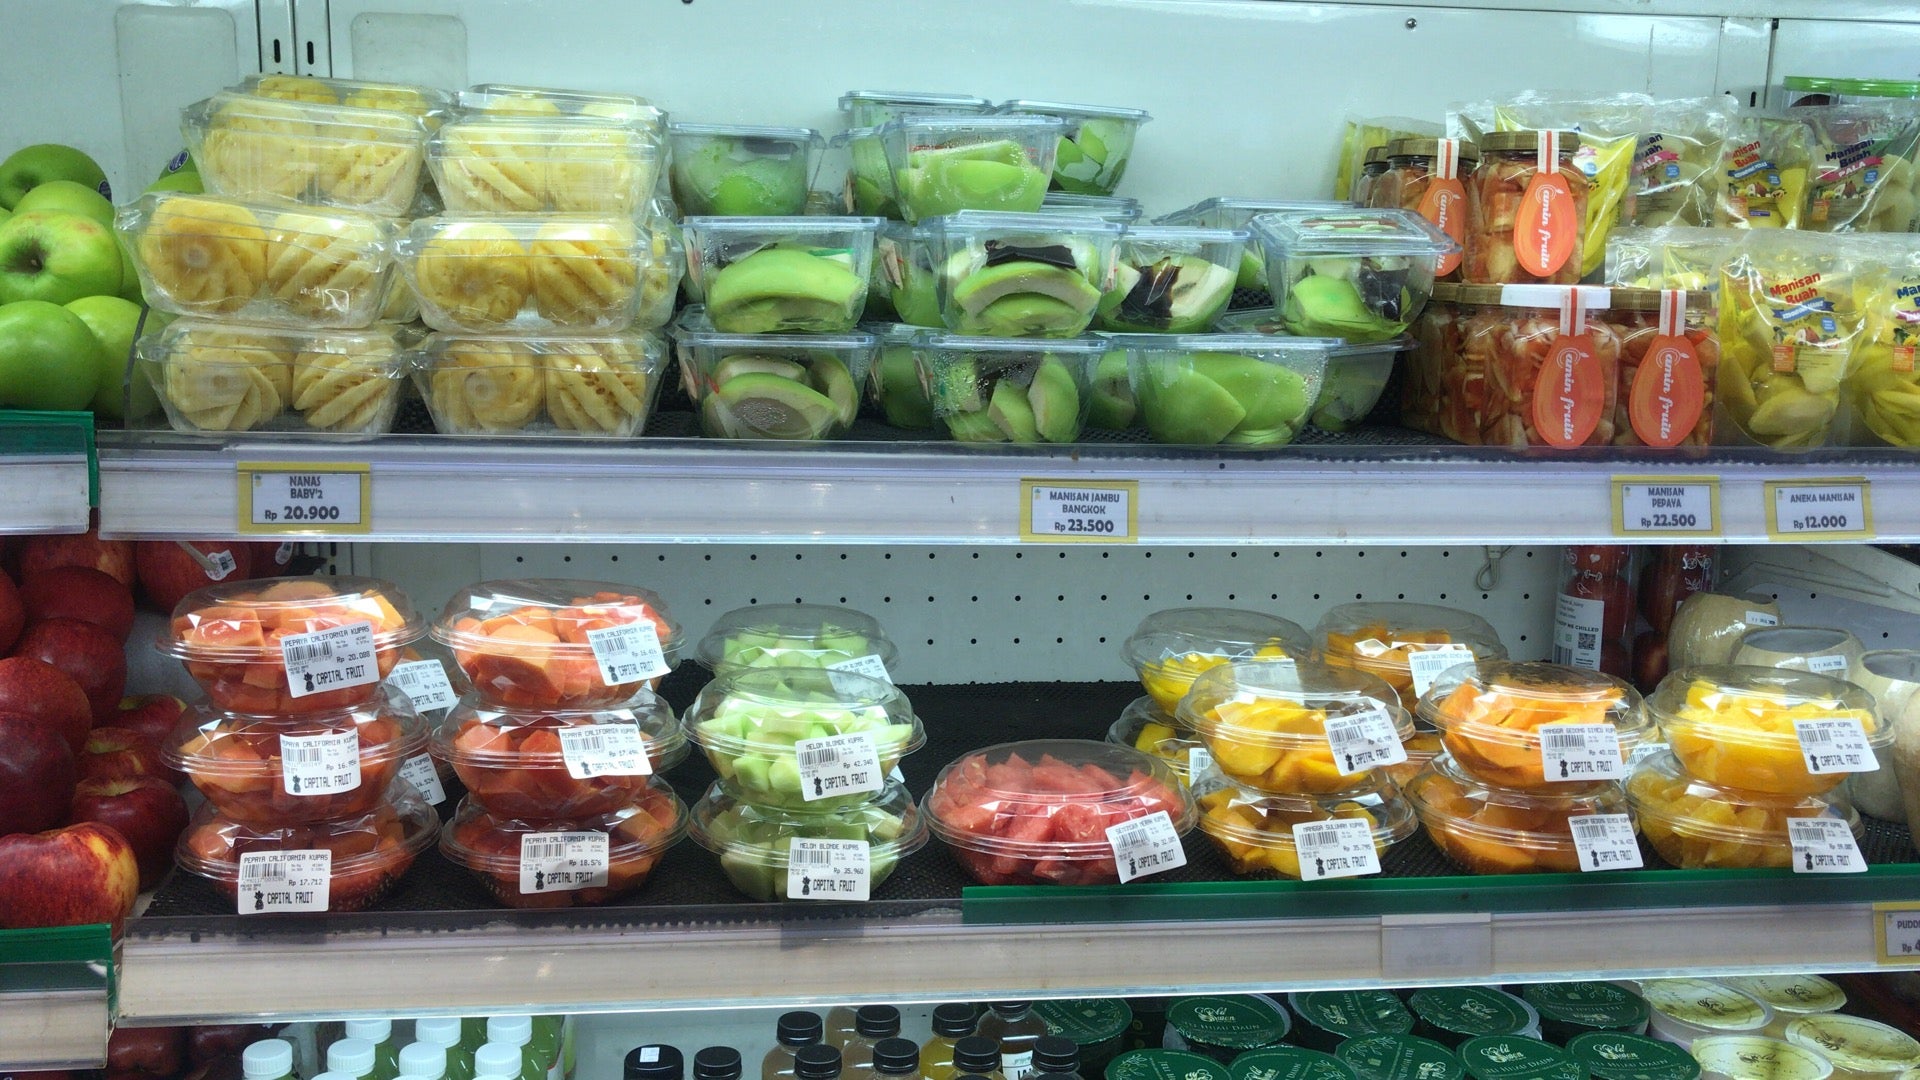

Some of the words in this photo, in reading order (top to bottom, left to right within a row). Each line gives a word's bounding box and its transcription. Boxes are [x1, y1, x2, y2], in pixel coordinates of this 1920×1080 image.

[1825, 138, 1875, 161] Manisan
[1735, 153, 1760, 168] Buah
[1840, 150, 1871, 168] Buah
[1838, 161, 1866, 178] PALA
[1538, 228, 1551, 269] fruits
[1769, 272, 1821, 298] Manisan
[1785, 288, 1818, 304] Buah
[1560, 395, 1575, 440] fruits
[1659, 396, 1674, 440] fruits
[290, 476, 321, 487] NANAS
[290, 488, 323, 499] BABY'2
[1050, 491, 1089, 502] MANISAN
[1091, 493, 1120, 503] JAMBU
[1648, 487, 1684, 496] MANISAN
[1790, 494, 1817, 503] ANEKA
[1819, 493, 1855, 502] MANISAN
[1062, 504, 1106, 515] BANGKOK
[1652, 498, 1682, 508] PEPAYA
[265, 510, 277, 521] Rp
[284, 506, 340, 520] 20.900
[1055, 522, 1066, 532] Rp
[1067, 519, 1114, 533] 23.500
[1641, 518, 1651, 528] Rp
[1653, 514, 1696, 527] 22.500
[1794, 520, 1804, 530] Rp
[1804, 515, 1847, 528] 12.000
[1575, 625, 1599, 633] CHILLED
[285, 638, 308, 647] PEPAYA
[310, 629, 348, 642] CALIFORNIA
[350, 626, 370, 635] KUPAS
[316, 670, 344, 685] CAPITAL
[346, 665, 365, 680] FRUIT
[618, 663, 640, 676] CAPITAL
[640, 660, 655, 672] FRUIT
[303, 739, 340, 747] CALIFORNIA
[806, 742, 824, 750] MELON
[825, 739, 845, 748] BLONDE
[1354, 751, 1375, 765] CAPITAL
[1376, 748, 1391, 760] FRUIT
[1820, 754, 1845, 766] CAPITAL
[1845, 754, 1861, 765] FRUIT
[592, 762, 618, 771] CAPITAL
[1570, 761, 1594, 773] CAPITAL
[1596, 761, 1612, 772] FRUIT
[304, 776, 331, 788] CAPITAL
[334, 772, 352, 786] FRUIT
[824, 775, 849, 789] CAPITAL
[851, 771, 869, 785] FRUIT
[244, 855, 266, 863] PEPAYA
[269, 854, 306, 862] CALIFORNIA
[1137, 854, 1160, 869] CAPITAL
[1160, 849, 1175, 862] FRUIT
[1326, 857, 1350, 870] CAPITAL
[1352, 855, 1368, 867] FRUIT
[1600, 850, 1620, 862] CAPITAL
[1620, 849, 1633, 861] FRUIT
[1815, 854, 1836, 866] CAPITAL
[1837, 855, 1851, 866] FRUIT
[547, 872, 572, 884] CAPITAL
[575, 871, 593, 883] FRUIT
[813, 879, 836, 892] CAPITAL
[839, 879, 856, 892] FRUIT
[267, 892, 292, 904] CAPITAL
[295, 891, 314, 904] FRUIT
[1902, 943, 1912, 953] Rp
